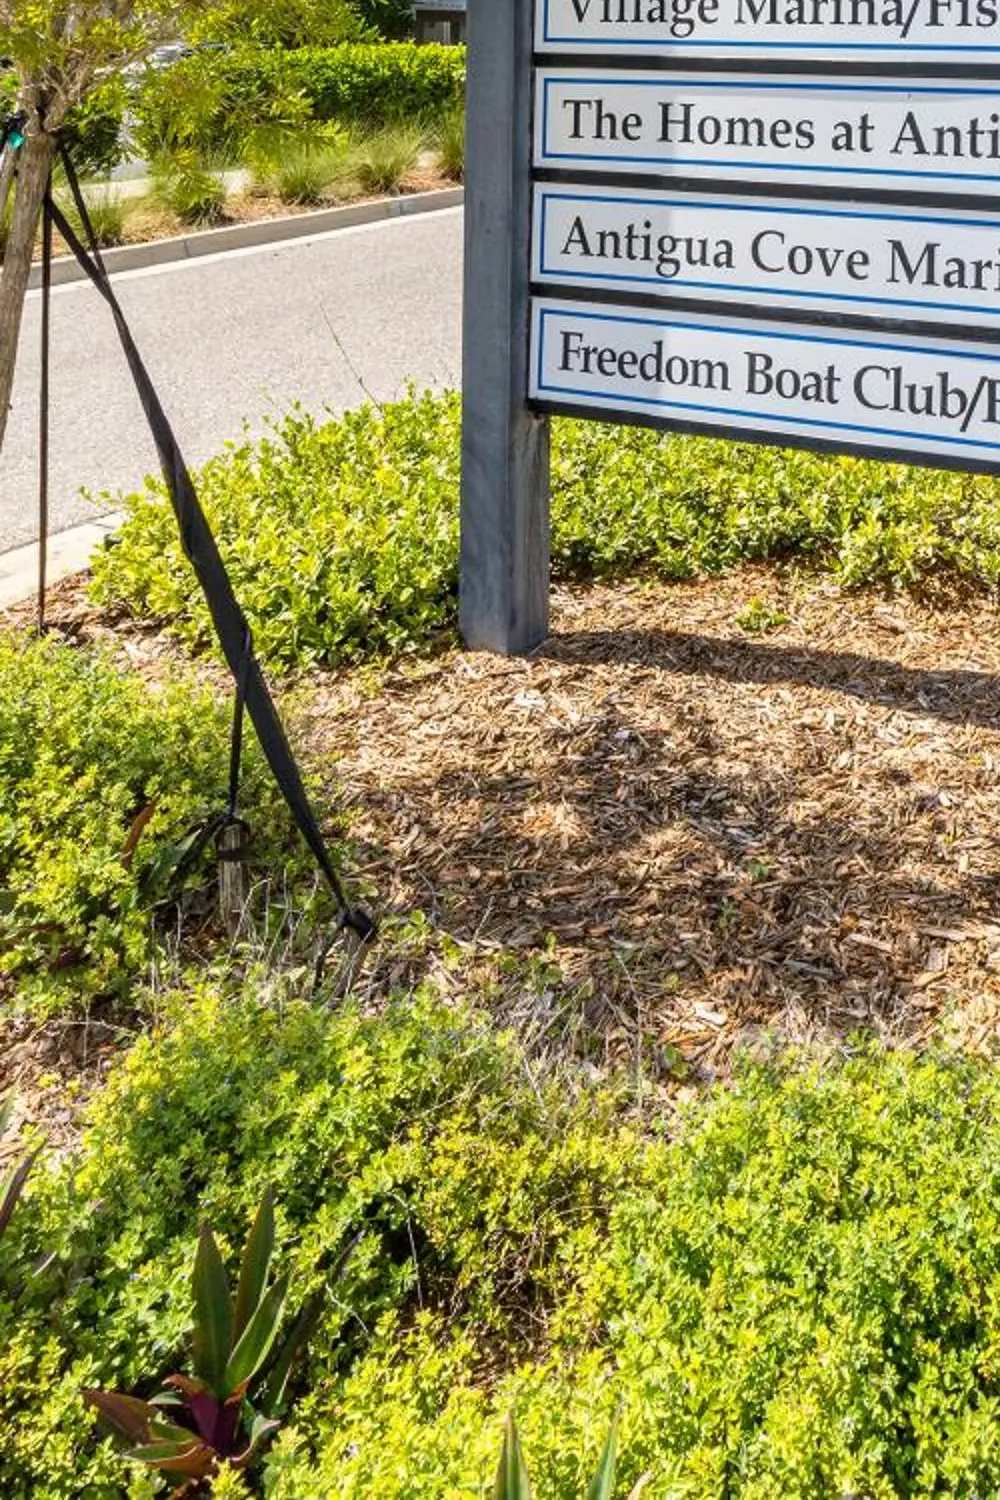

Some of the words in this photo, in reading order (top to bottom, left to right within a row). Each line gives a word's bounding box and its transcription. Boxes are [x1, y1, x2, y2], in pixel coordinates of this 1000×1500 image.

[563, 99, 643, 142] The
[657, 102, 815, 150] Homes
[831, 113, 875, 153] at
[561, 216, 734, 278] Antigua
[751, 230, 871, 281] Cove
[559, 330, 731, 391] Freedom
[744, 351, 841, 404] Boat
